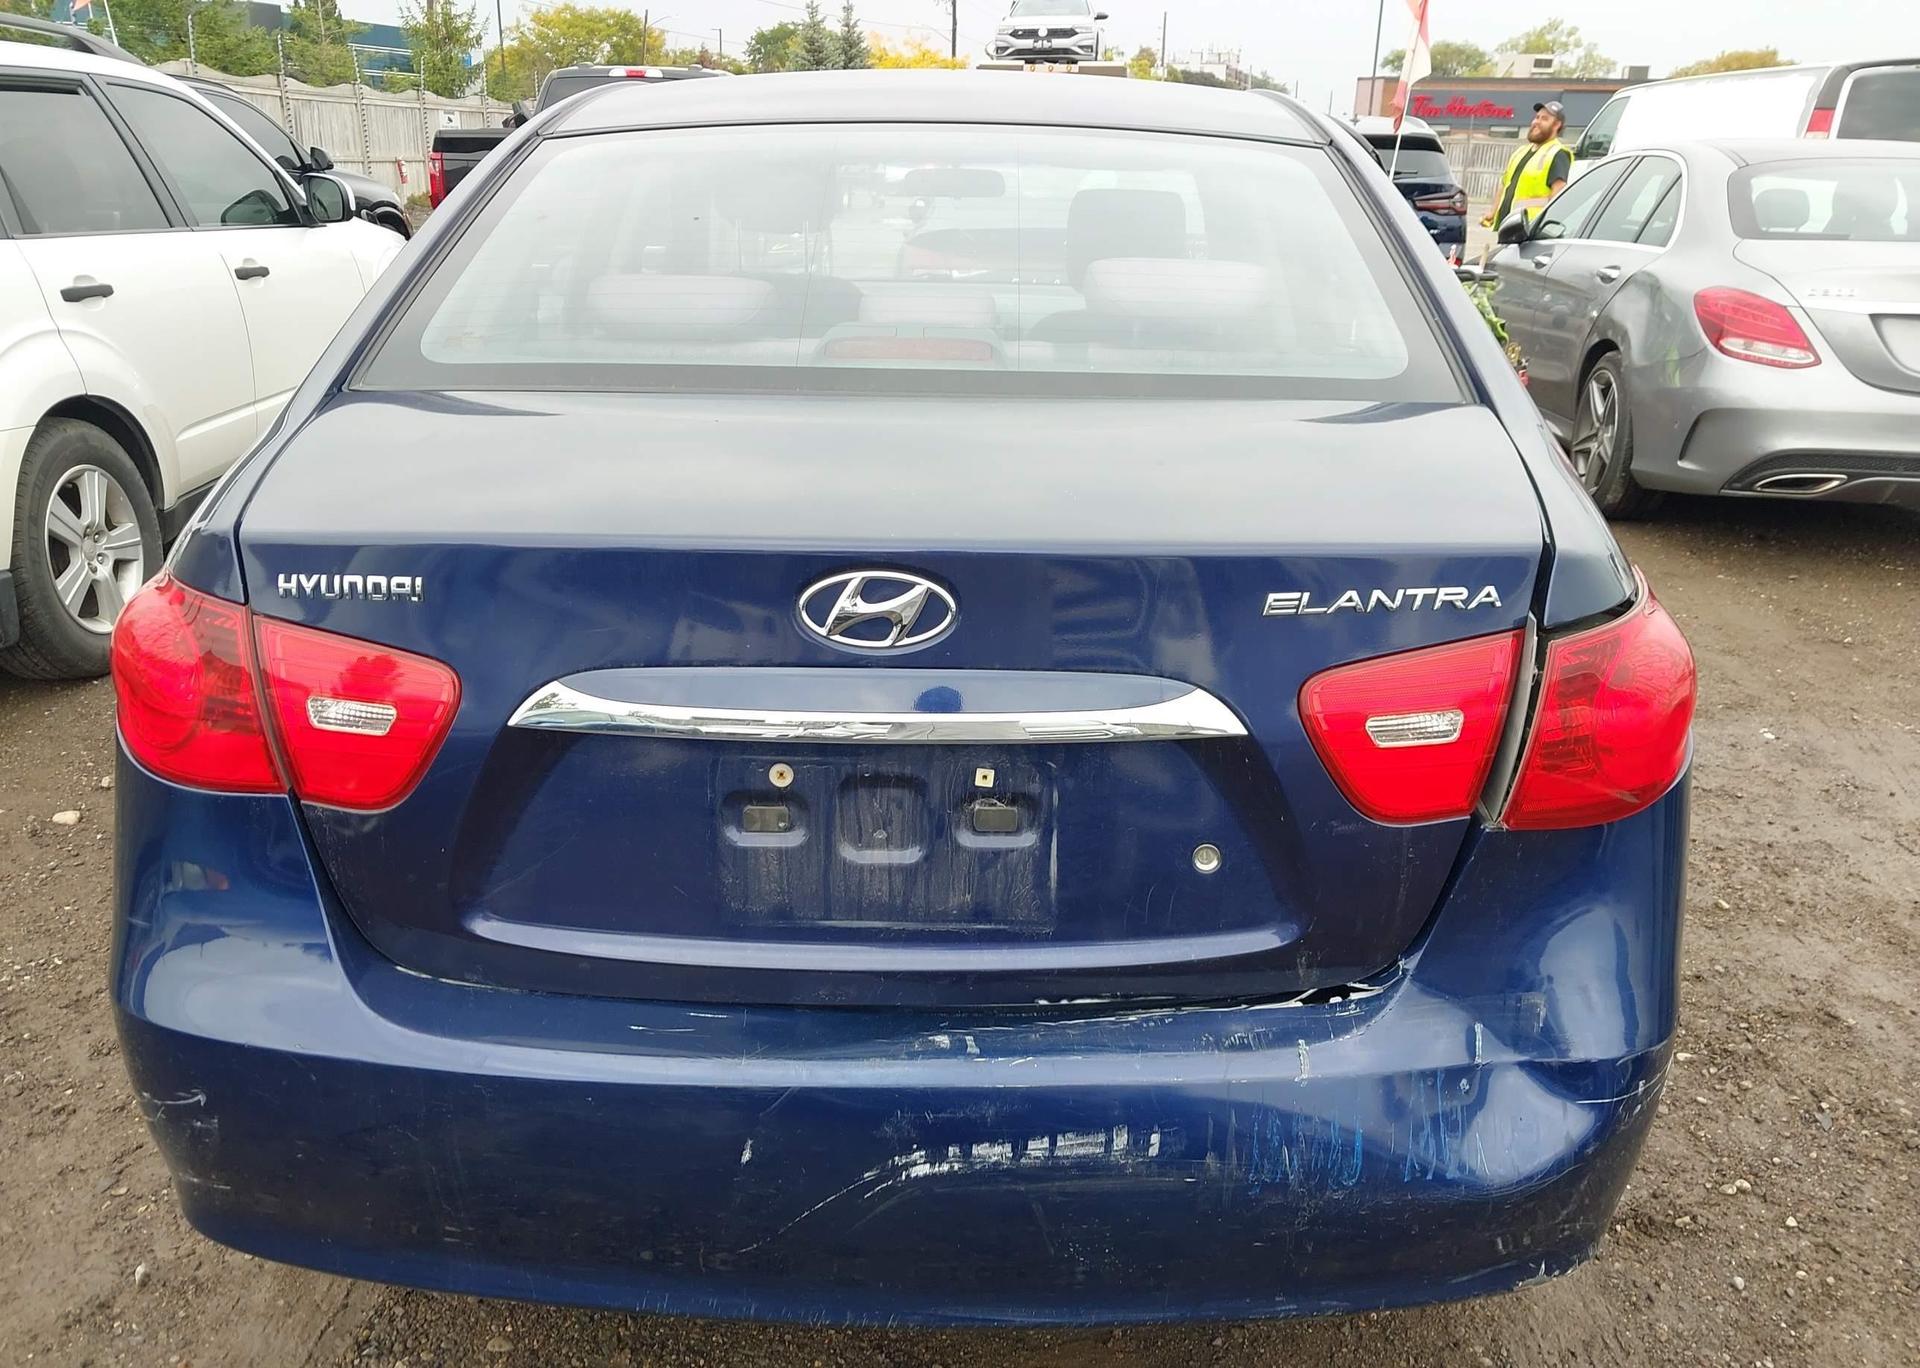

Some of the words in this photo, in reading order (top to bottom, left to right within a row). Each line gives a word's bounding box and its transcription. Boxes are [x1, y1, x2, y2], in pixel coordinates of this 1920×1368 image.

[1411, 95, 1441, 118] Tim
[277, 573, 423, 602] HYUNDAI
[1262, 584, 1503, 616] ELANTRA
